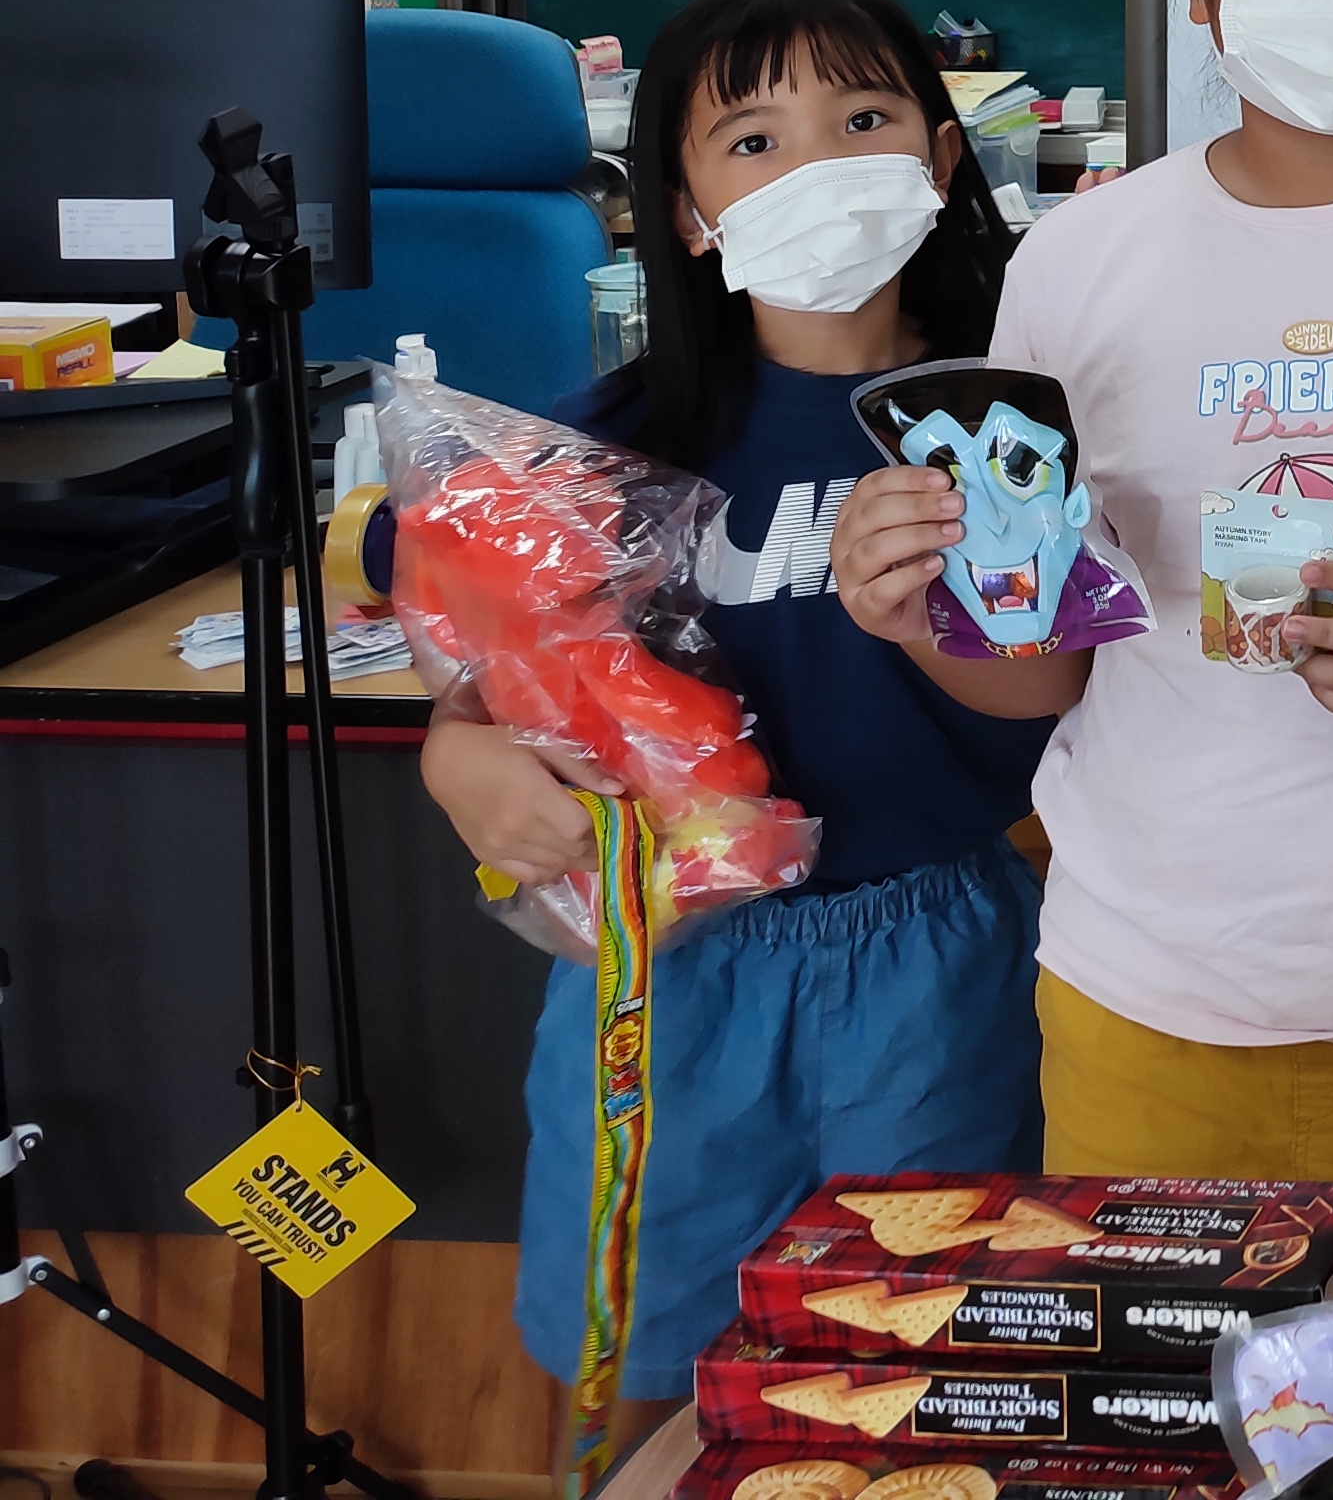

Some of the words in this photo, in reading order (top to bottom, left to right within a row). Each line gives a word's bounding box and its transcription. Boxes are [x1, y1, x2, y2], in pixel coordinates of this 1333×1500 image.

[1286, 323, 1328, 346] SUNNY
[1295, 333, 1327, 351] SIDE
[55, 343, 95, 367] MEMO
[251, 1153, 357, 1248] STANDS
[232, 1176, 264, 1205] YOU
[256, 1200, 289, 1229] CAN
[281, 1221, 329, 1264] TRUST!
[1066, 1243, 1224, 1267] Walkers
[980, 1290, 1070, 1311] TRIANGLES
[955, 1306, 1095, 1332] SHORTBREAD
[1125, 1305, 1250, 1334] Walkers
[943, 1381, 1035, 1400] TRIANGLES
[918, 1396, 1061, 1420] SHORTBREAD
[1092, 1395, 1220, 1426] Walkers
